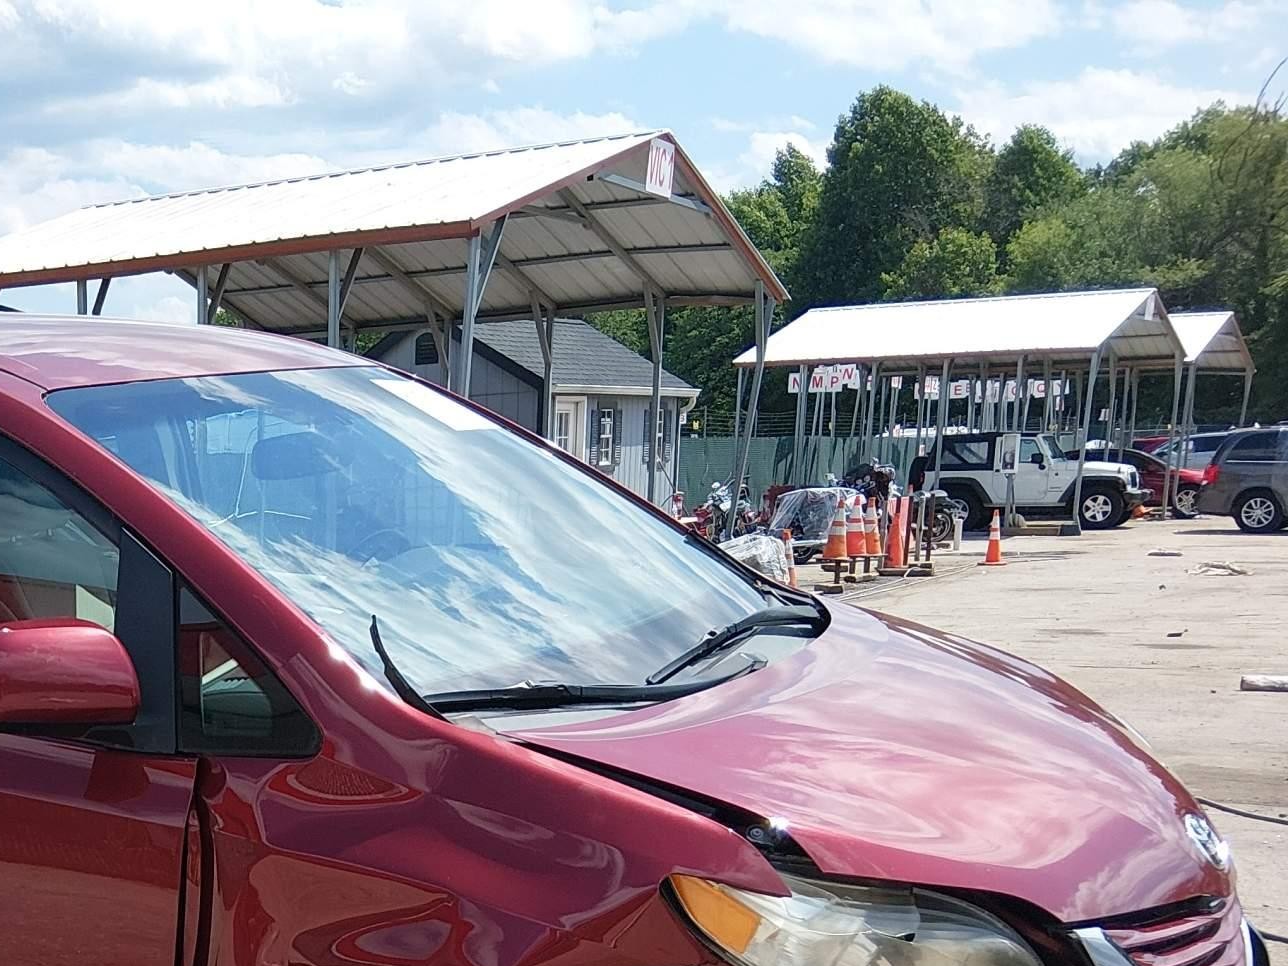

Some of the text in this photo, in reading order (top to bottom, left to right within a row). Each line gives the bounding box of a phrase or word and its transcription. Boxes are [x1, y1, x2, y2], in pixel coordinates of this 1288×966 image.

[648, 143, 668, 187] VIC
[812, 376, 823, 388] M
[830, 376, 839, 388] P
[954, 385, 962, 395] E
